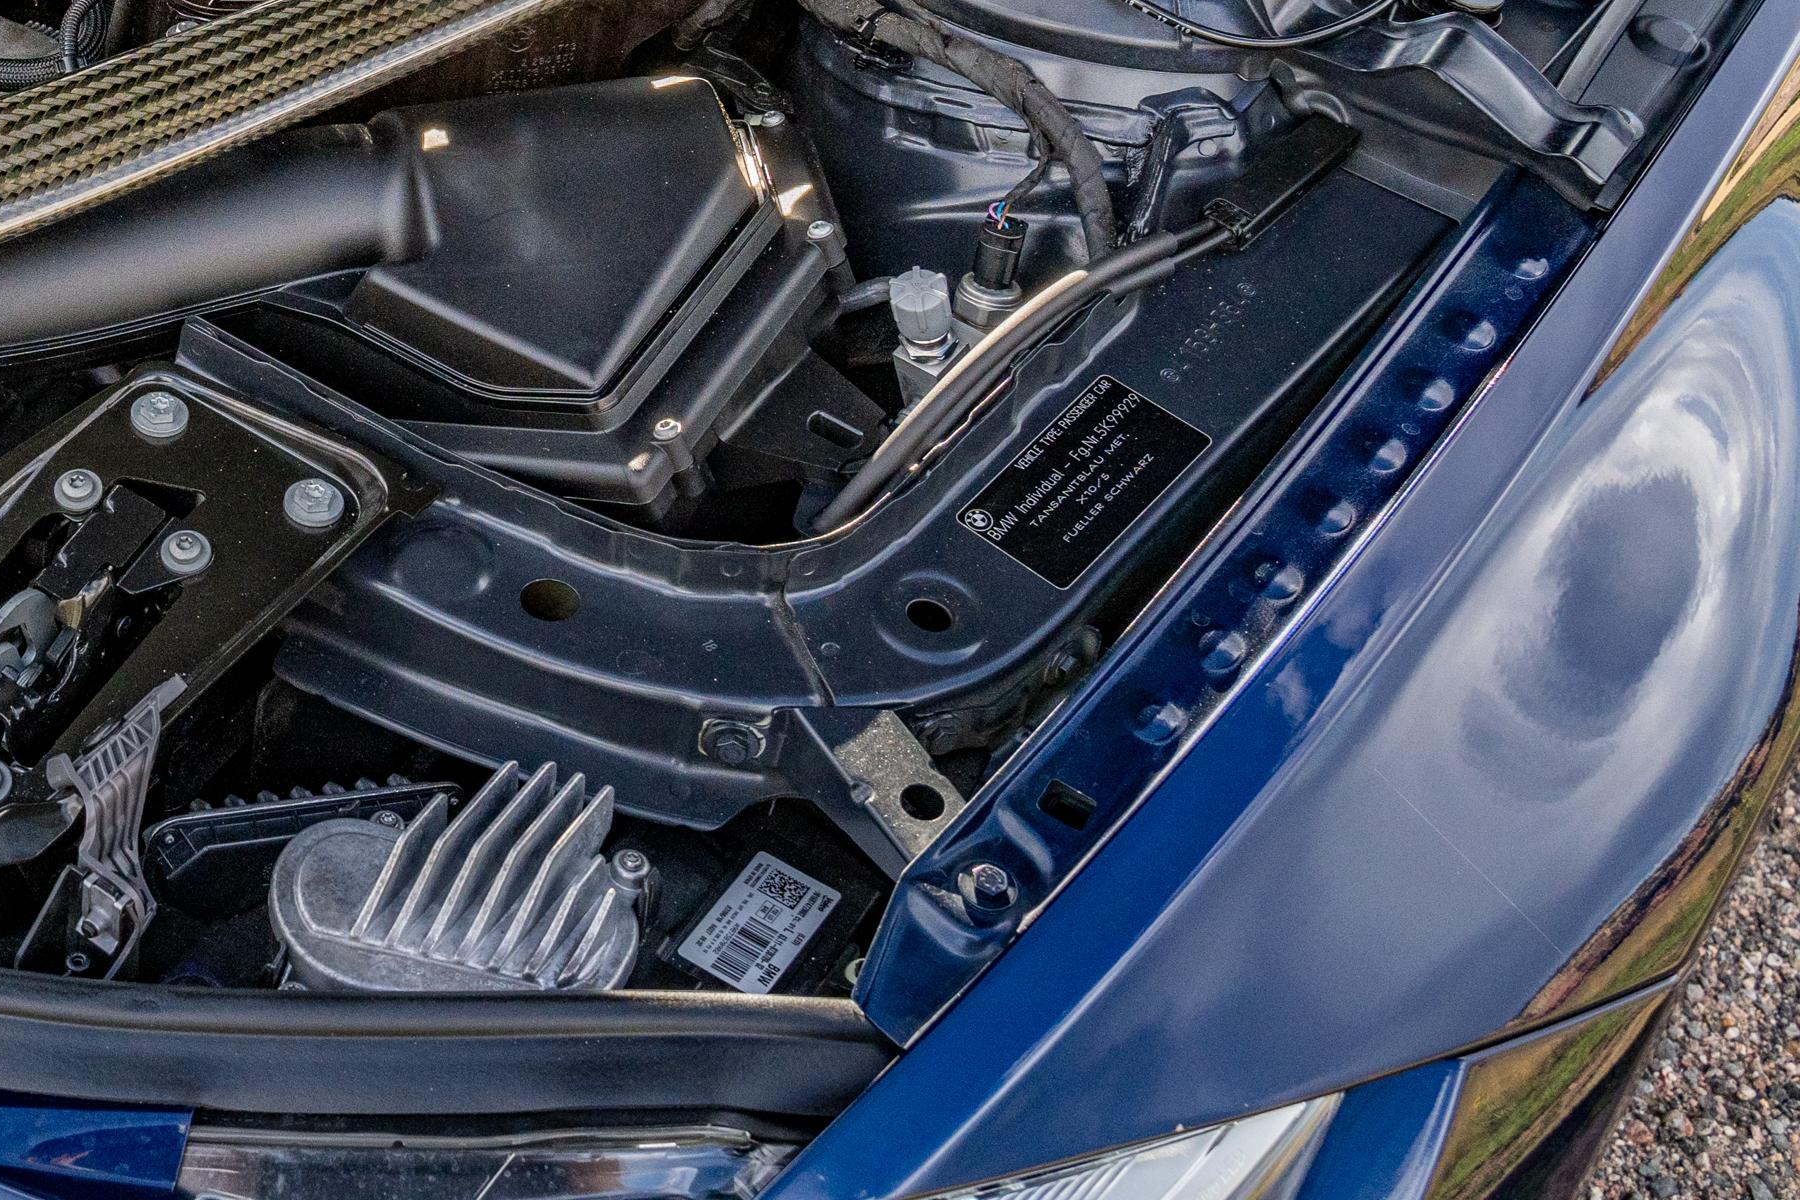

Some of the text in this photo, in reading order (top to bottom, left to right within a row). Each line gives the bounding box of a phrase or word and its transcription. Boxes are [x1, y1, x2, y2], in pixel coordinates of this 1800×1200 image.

[1013, 378, 1112, 471] VEHICLE TYPE: PASSENGER CAR
[986, 511, 1020, 541] BMW
[1013, 467, 1065, 514] Individual
[1028, 430, 1130, 528] TANSANITBLAU MET.
[1061, 452, 1155, 543] FUELLER SCHWARZ
[1075, 471, 1111, 504] X10/5
[755, 963, 780, 986] BMW
